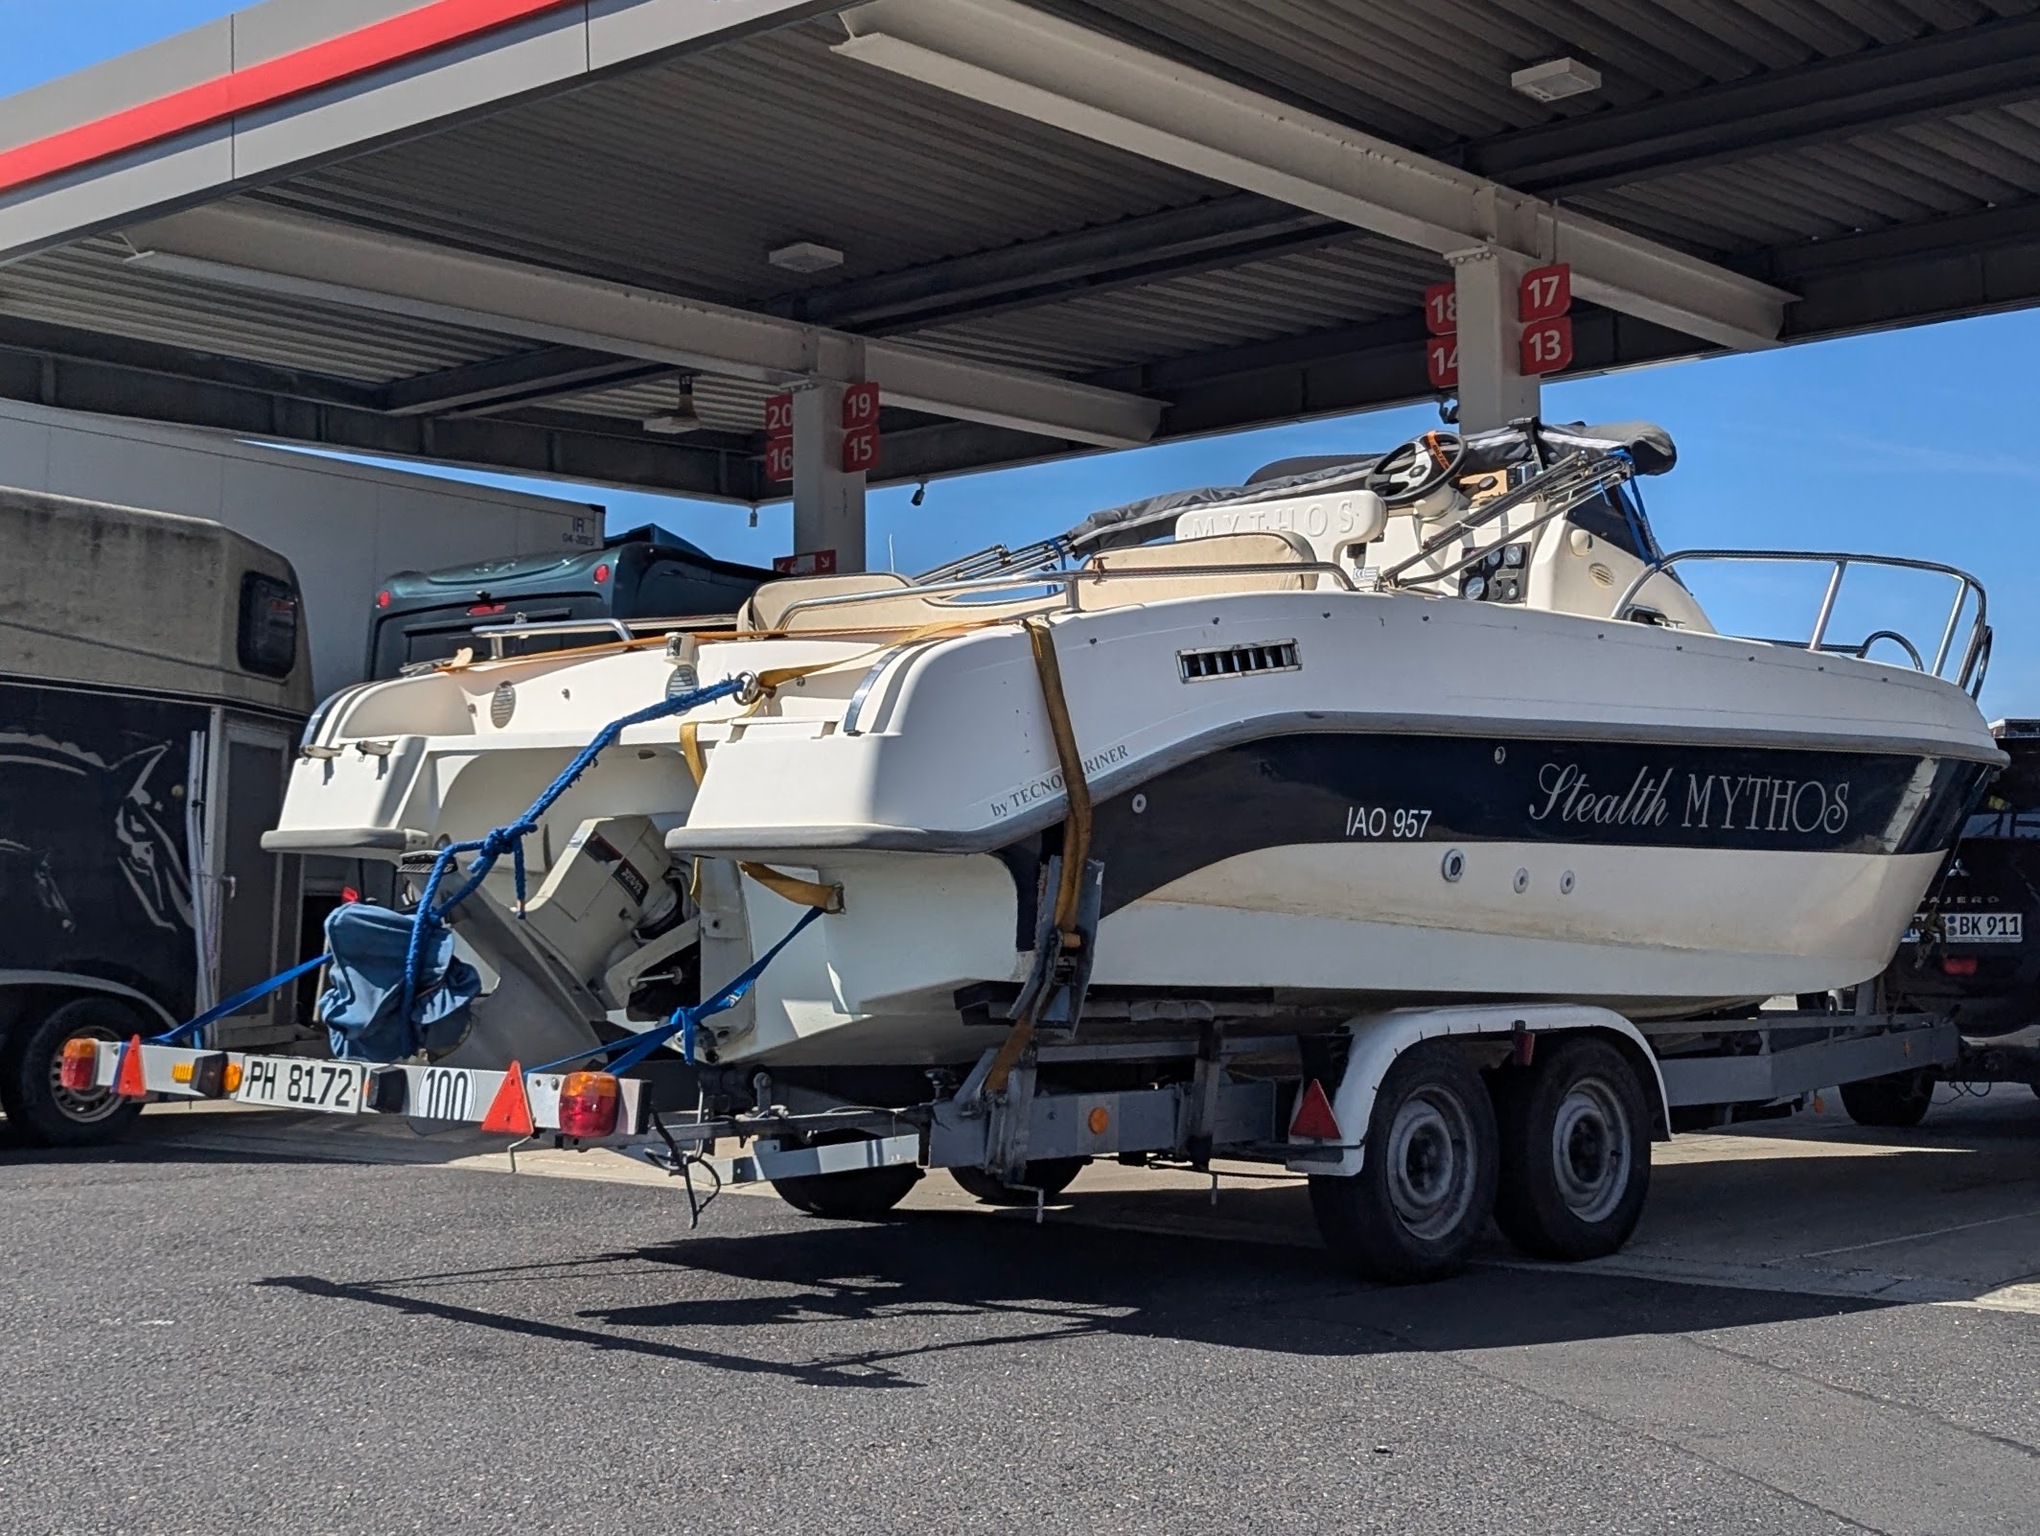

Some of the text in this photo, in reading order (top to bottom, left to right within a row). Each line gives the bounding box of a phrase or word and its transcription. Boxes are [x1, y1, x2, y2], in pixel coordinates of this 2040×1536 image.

[1527, 275, 1560, 309] 17
[1528, 329, 1562, 363] 13
[768, 403, 793, 430] 20
[847, 392, 871, 419] 19
[770, 446, 793, 472] 16
[849, 435, 873, 462] 15
[1192, 499, 1355, 538] MYTHOS
[990, 744, 1129, 818] by TECNORINER
[1528, 762, 1850, 834] Stealth MYTHOS
[1345, 806, 1433, 838] IAO 957
[1959, 915, 1982, 936] BK
[1986, 915, 2020, 936] 911
[245, 1060, 352, 1107] PH 8172
[426, 1069, 469, 1121] 100
